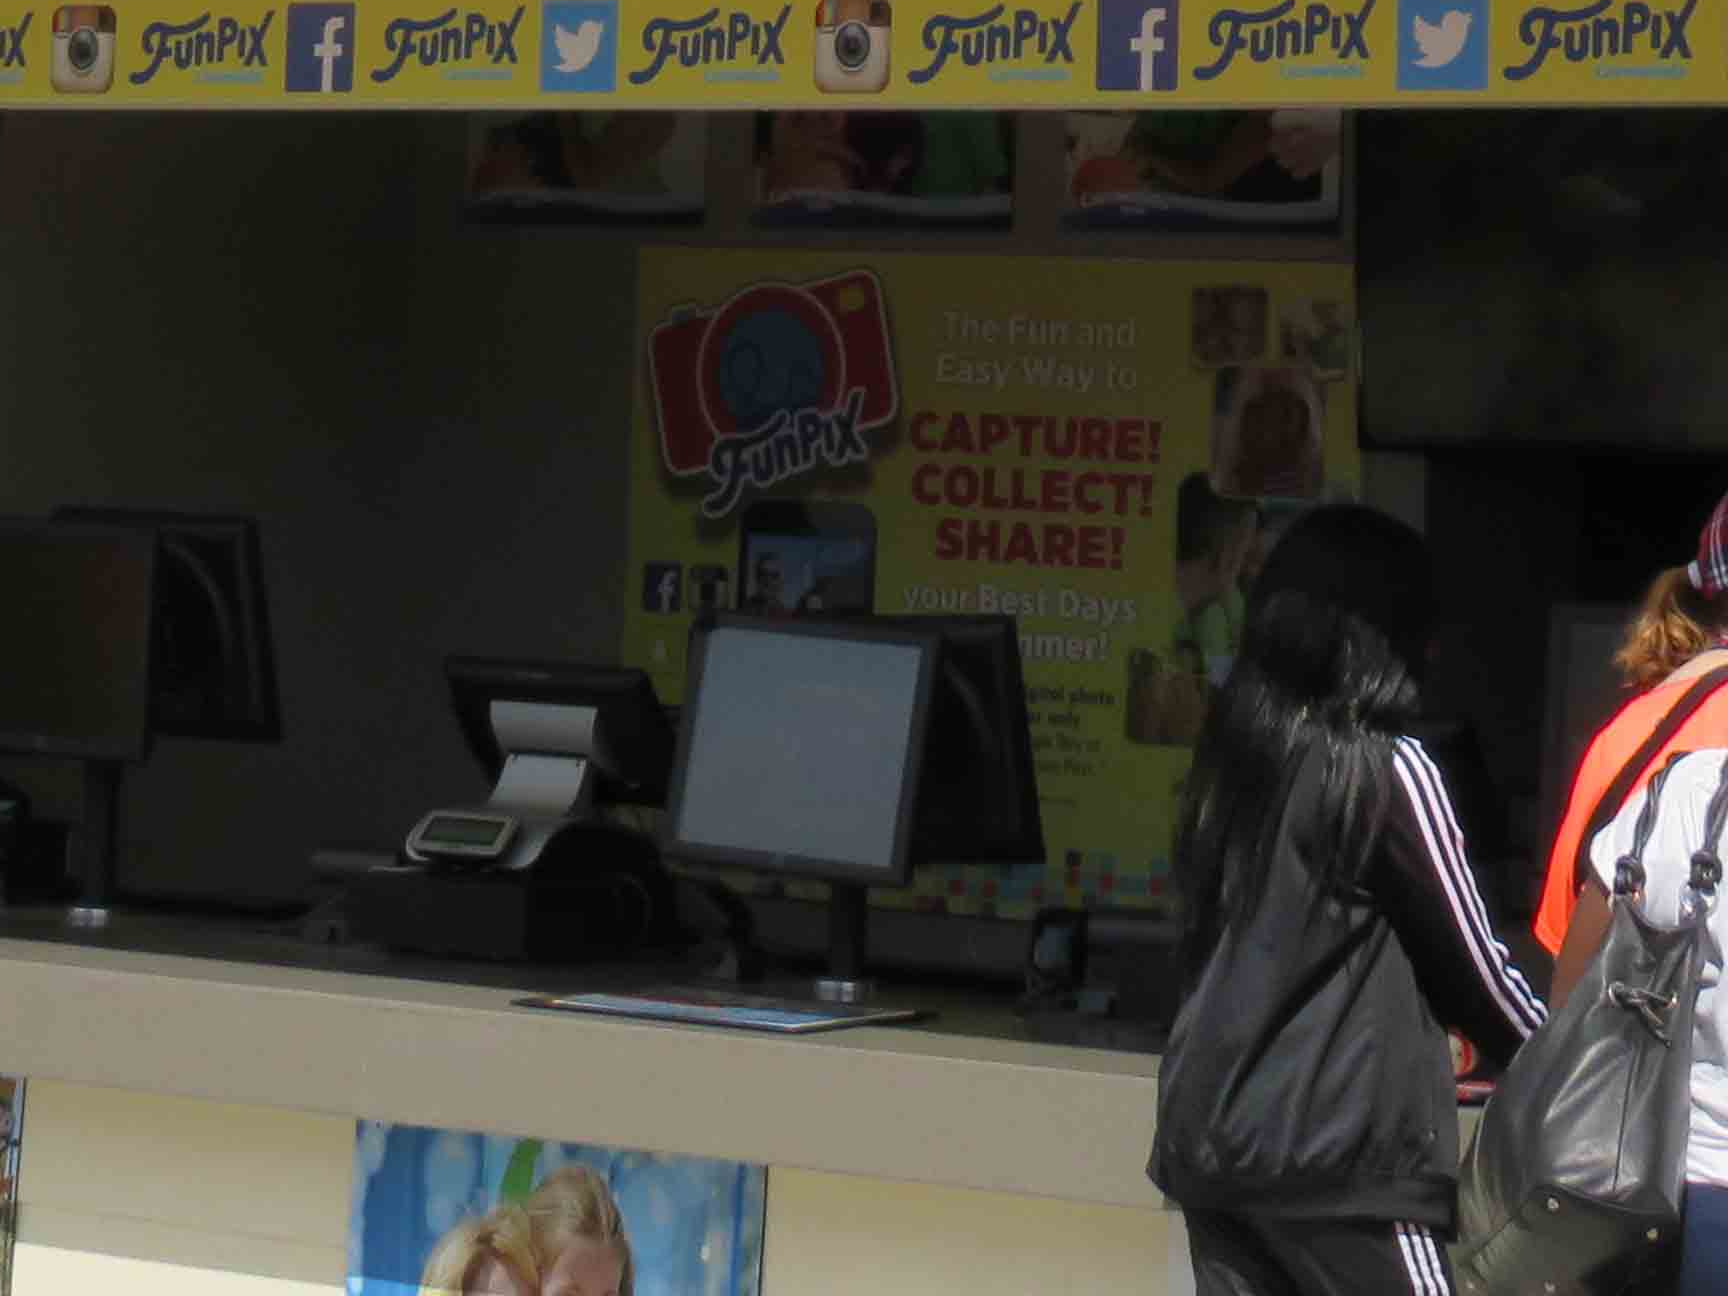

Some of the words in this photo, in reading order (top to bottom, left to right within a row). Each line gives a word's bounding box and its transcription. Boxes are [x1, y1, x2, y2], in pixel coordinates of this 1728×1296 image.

[943, 311, 1001, 344] The
[1008, 312, 1072, 345] Fun
[1079, 318, 1137, 350] and
[935, 352, 1008, 392] Easy
[1022, 353, 1096, 393] Way
[1106, 360, 1138, 392] to
[910, 412, 1162, 465] CAPTURE!
[912, 464, 1154, 518] COLLECT!
[936, 518, 1125, 570] SHARE!
[977, 583, 1049, 616] Best
[1057, 588, 1138, 626] Days
